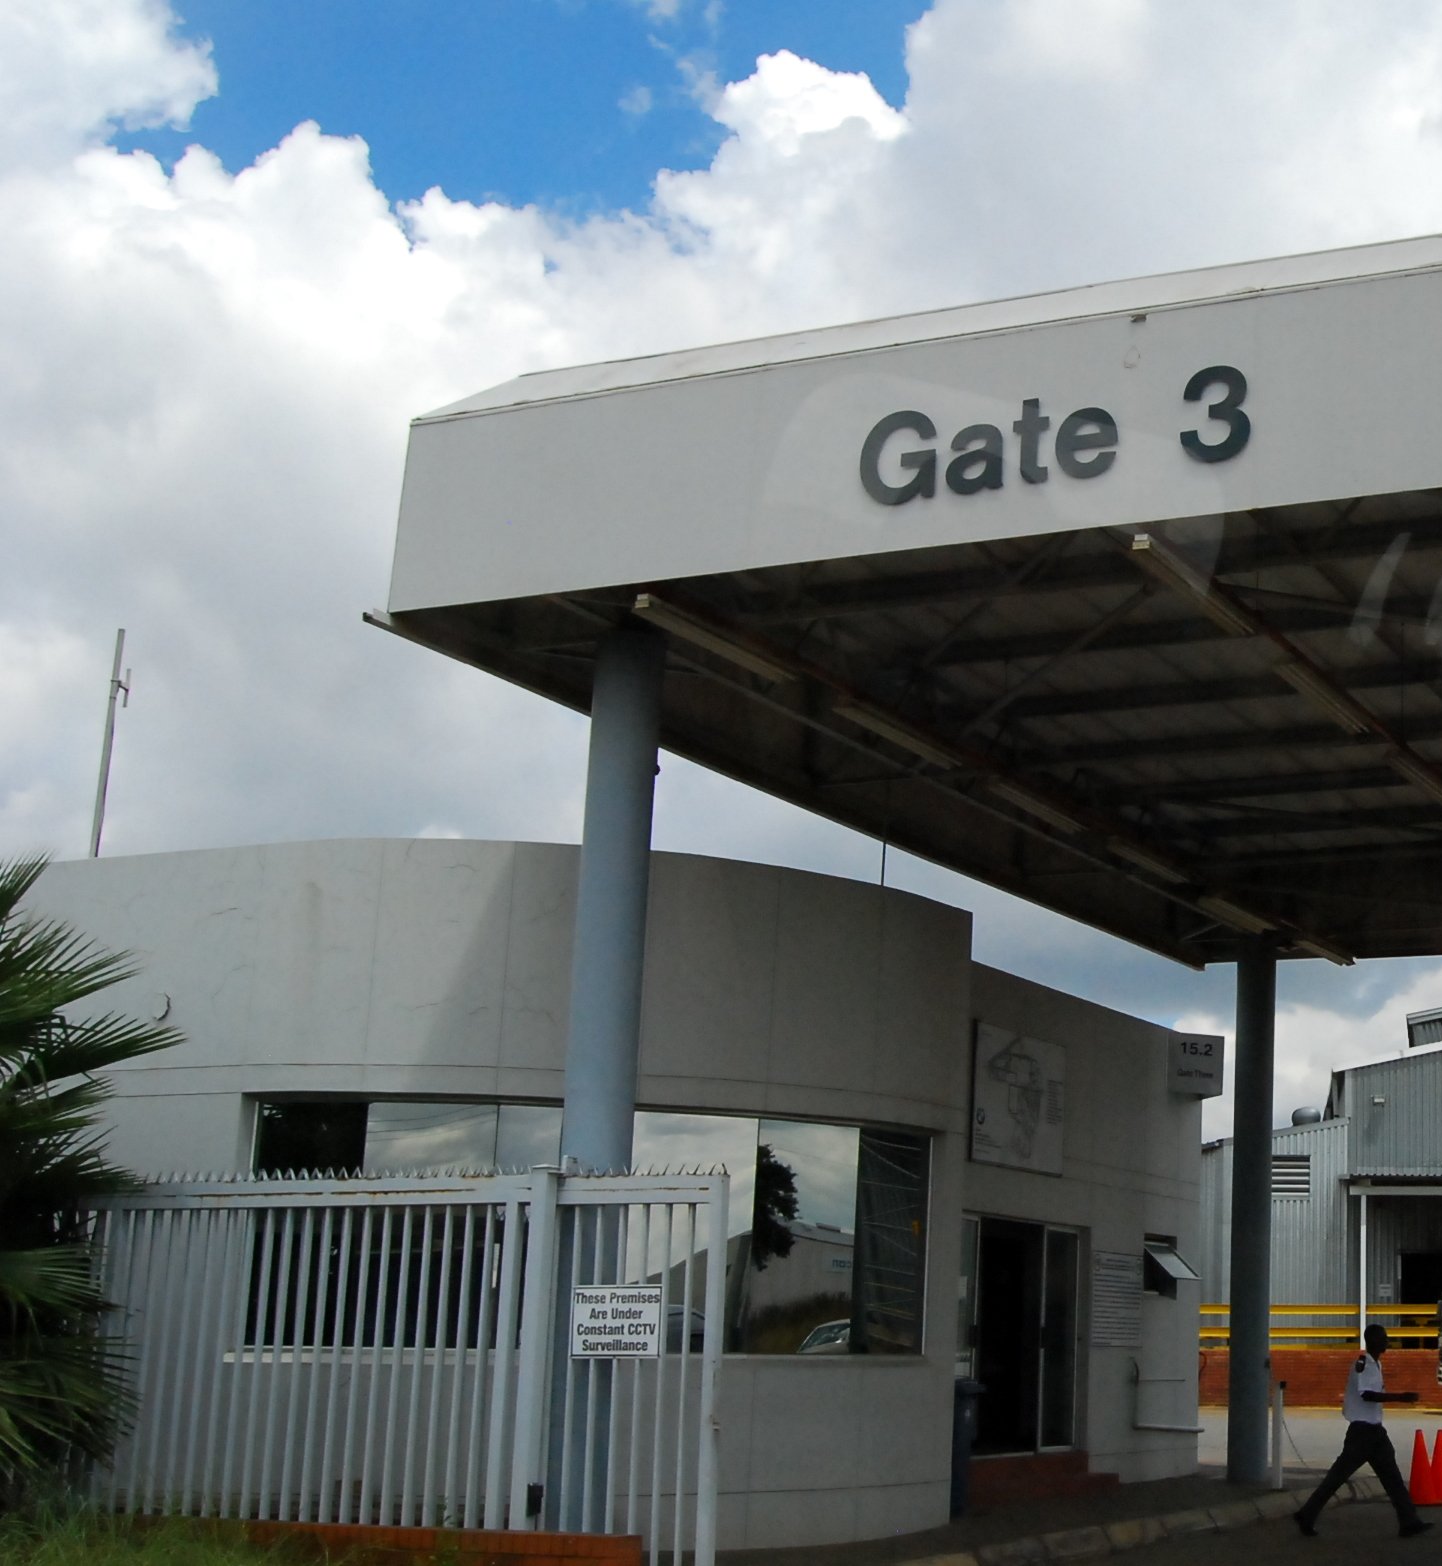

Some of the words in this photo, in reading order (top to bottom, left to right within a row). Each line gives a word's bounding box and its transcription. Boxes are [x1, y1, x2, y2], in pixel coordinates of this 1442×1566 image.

[859, 397, 1120, 506] Gate
[1179, 364, 1252, 464] 3
[1180, 1041, 1213, 1057] 15.2
[575, 1292, 606, 1304] These
[609, 1292, 660, 1304] Premises
[589, 1308, 608, 1320] Are
[611, 1308, 643, 1320] Under
[577, 1323, 625, 1336] Constant
[627, 1323, 656, 1336] CCTV
[582, 1339, 648, 1352] Surveillance
